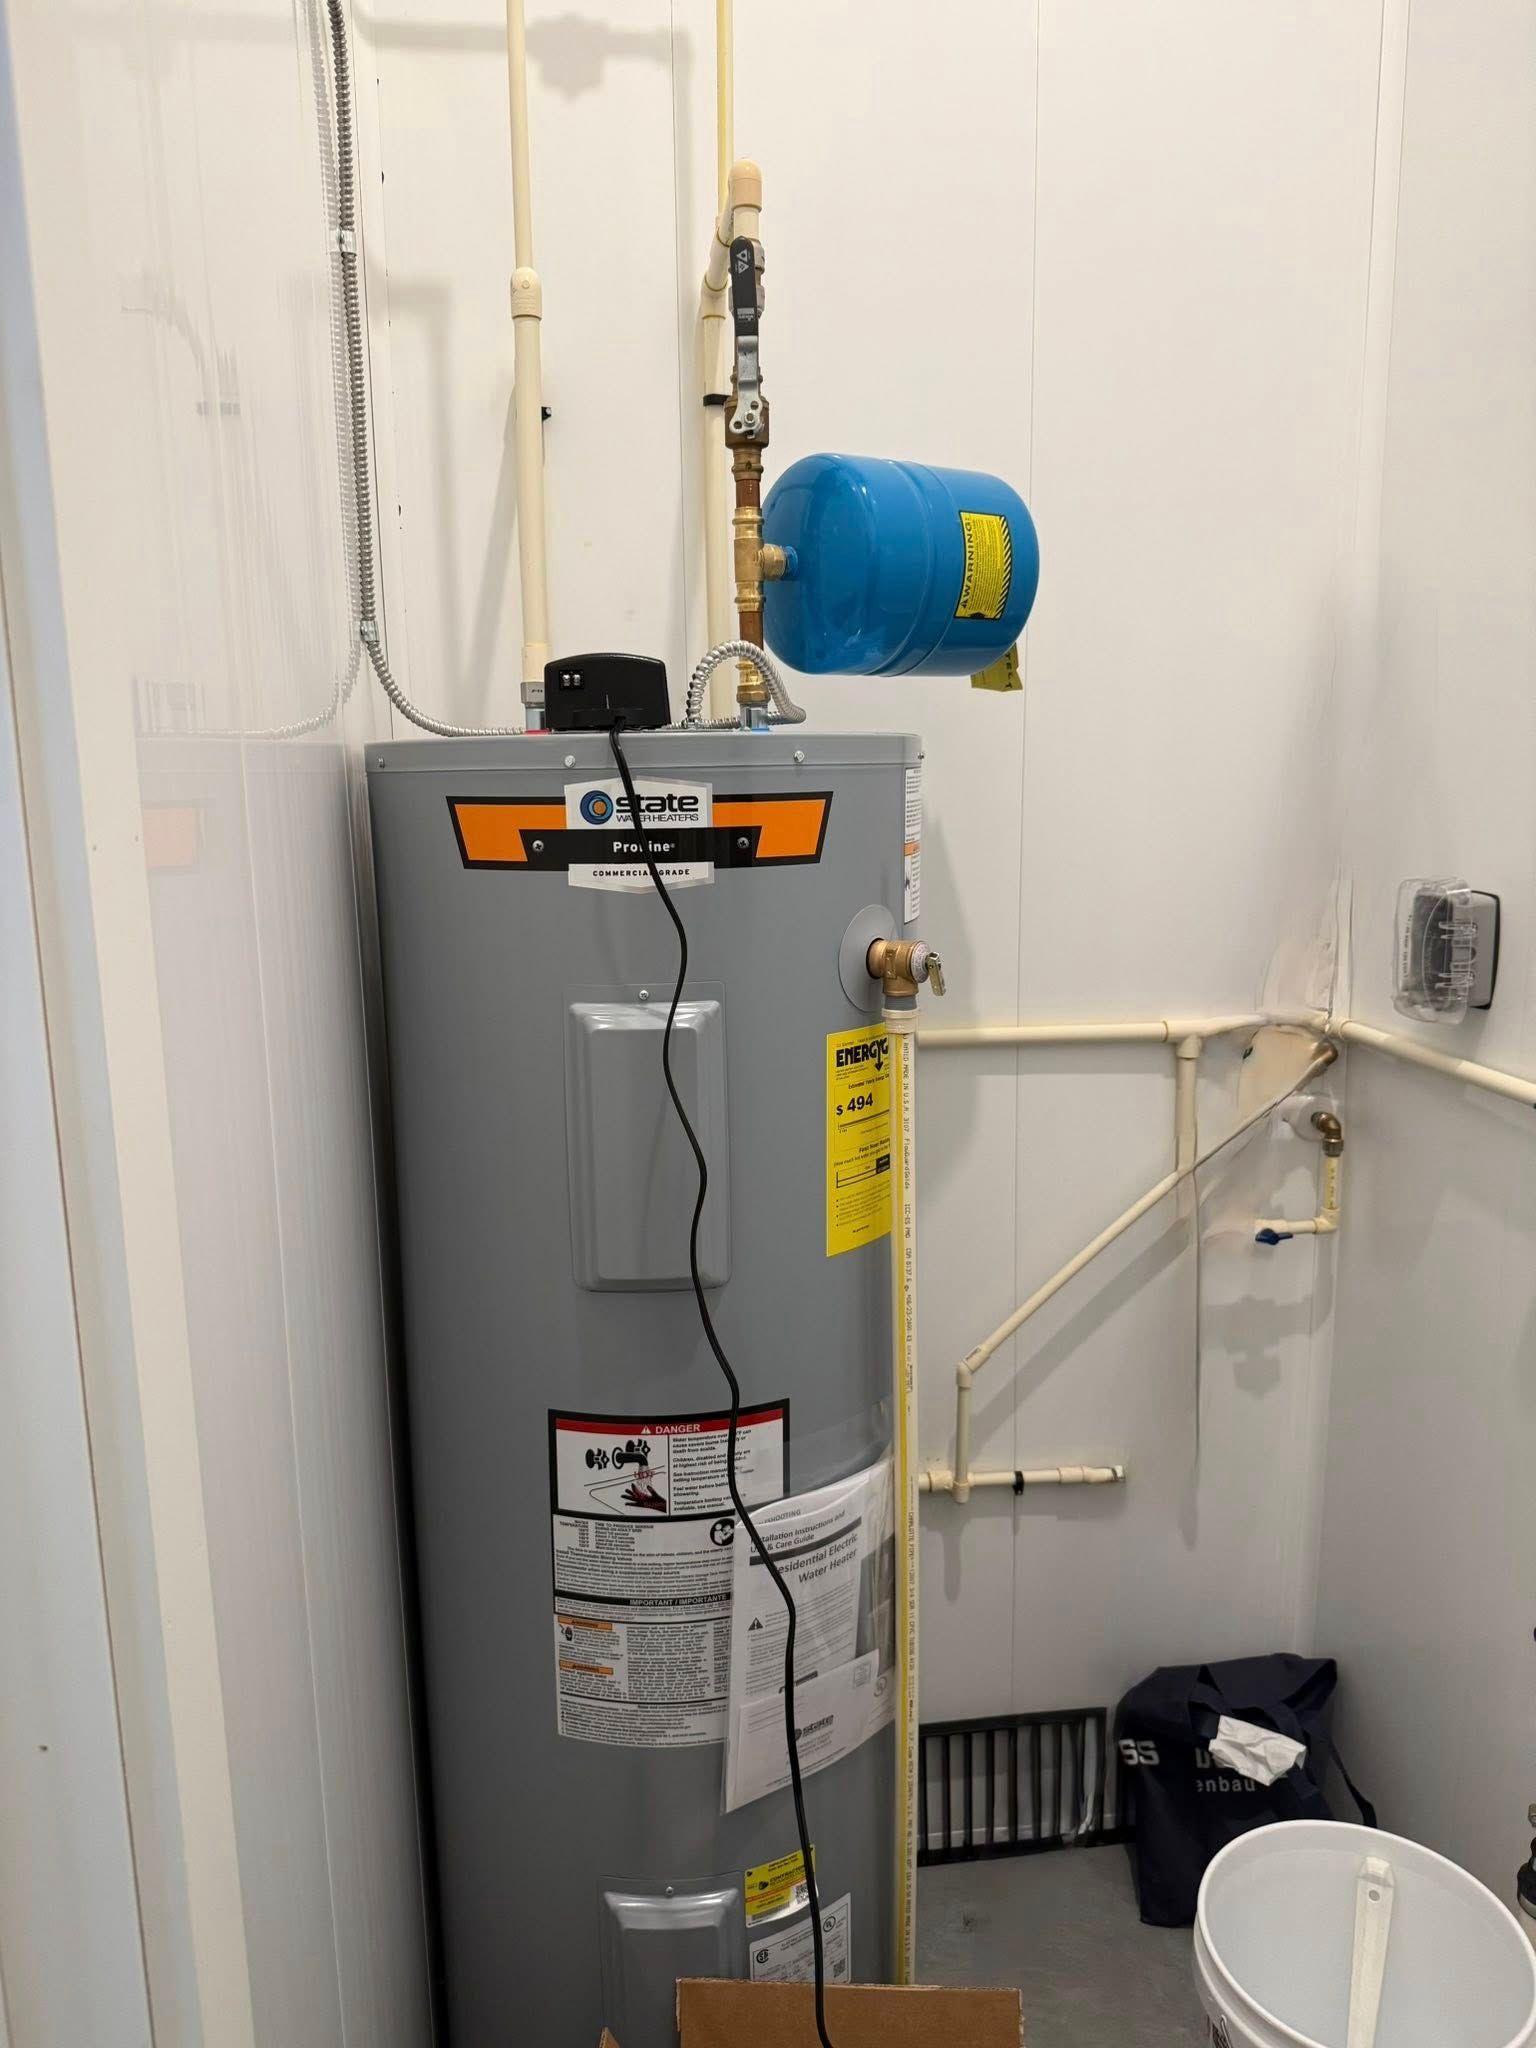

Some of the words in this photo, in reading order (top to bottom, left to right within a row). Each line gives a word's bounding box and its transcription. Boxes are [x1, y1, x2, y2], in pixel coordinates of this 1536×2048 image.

[616, 794, 699, 813] state
[616, 815, 651, 823] WAER
[652, 813, 699, 823] HEATERS
[659, 868, 690, 876] GRADE
[847, 1092, 874, 1112] 494
[655, 1423, 701, 1435] DANGER
[776, 1540, 792, 1549] Care
[793, 1534, 815, 1544] Guide
[778, 1550, 827, 1574] esidential
[828, 1533, 858, 1556] Electric
[798, 1564, 827, 1583] Water
[830, 1549, 857, 1570] Heater
[679, 1594, 727, 1605] IMPORTANTE
